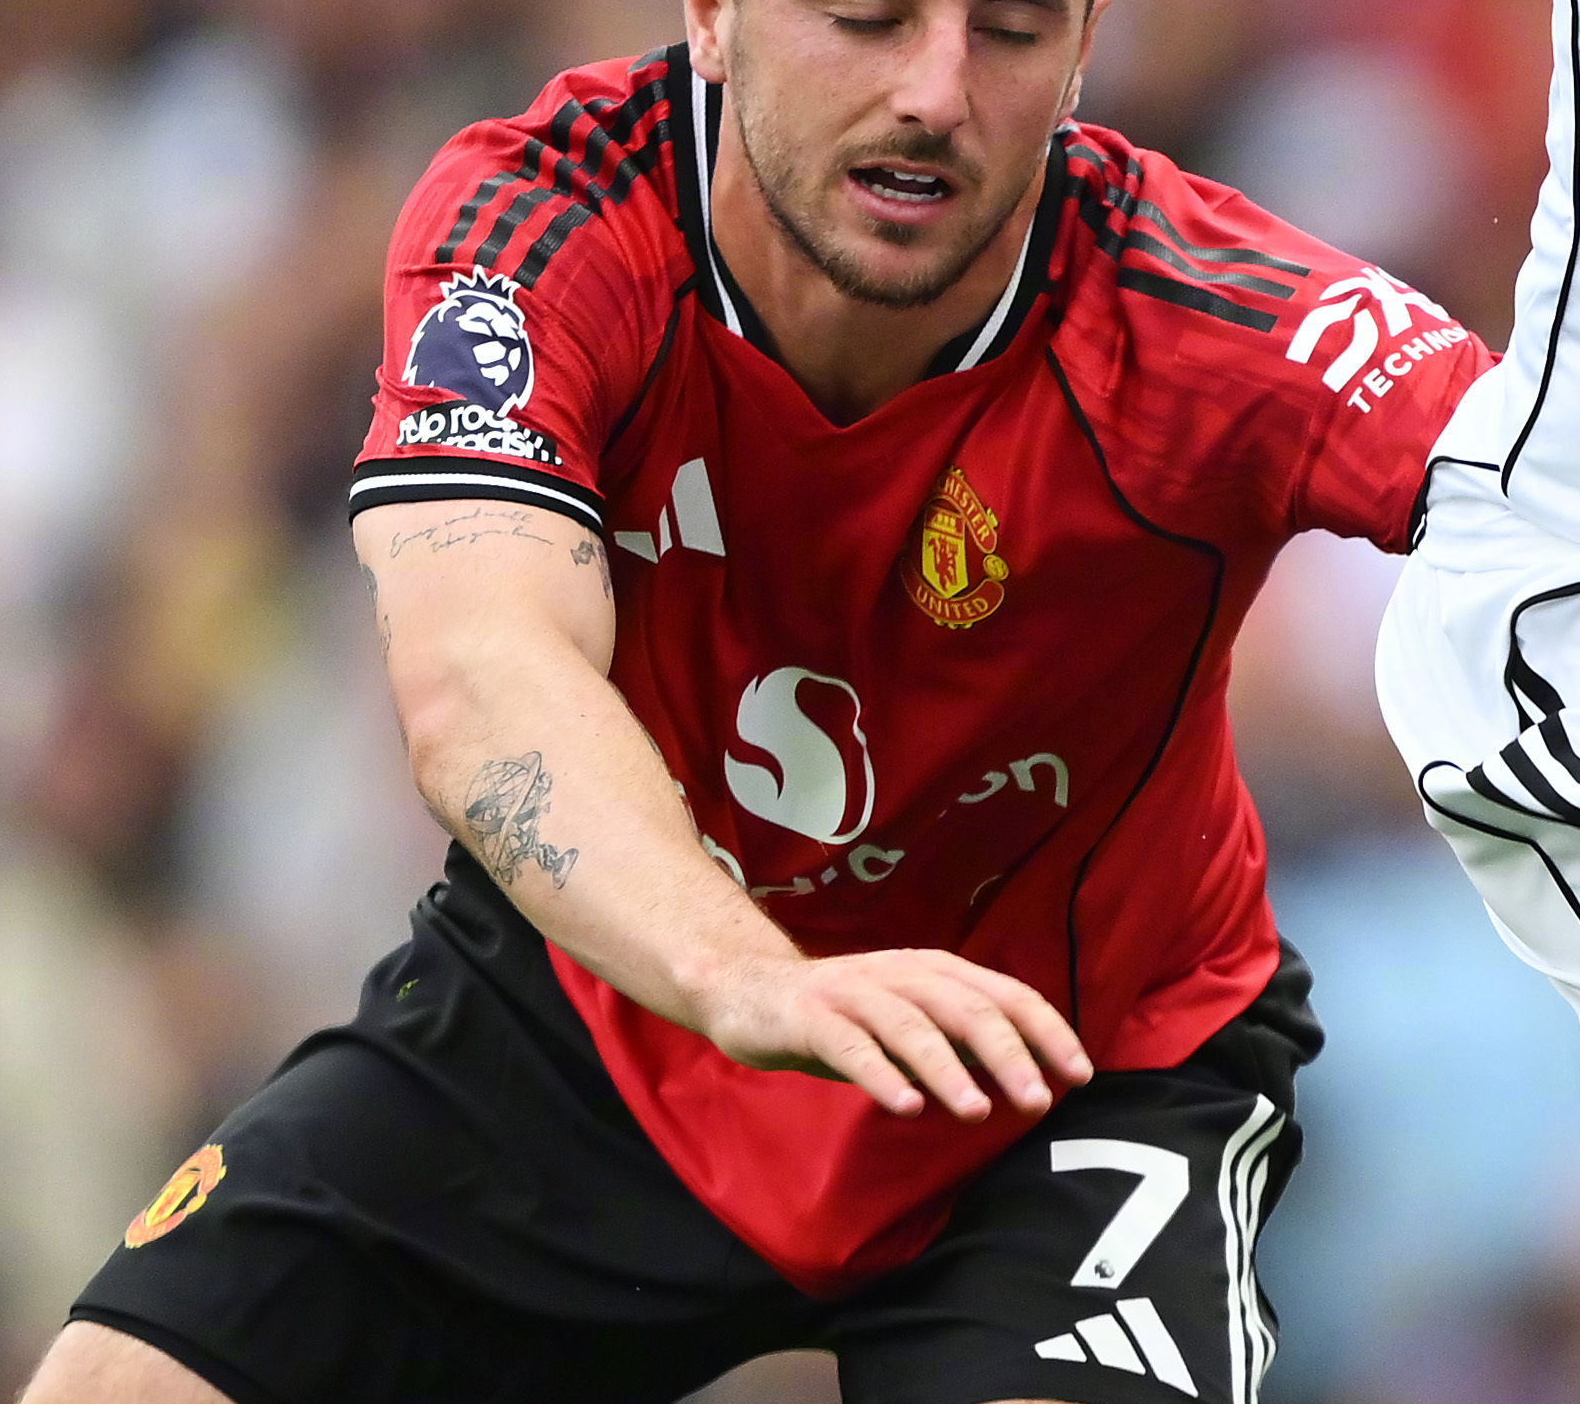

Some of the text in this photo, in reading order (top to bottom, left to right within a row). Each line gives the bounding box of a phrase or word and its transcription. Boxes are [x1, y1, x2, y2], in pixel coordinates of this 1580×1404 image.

[1347, 327, 1470, 414] TECHNO
[942, 475, 991, 543] HESTER
[916, 584, 990, 619] UNITED
[1050, 1138, 1190, 1289] 7
